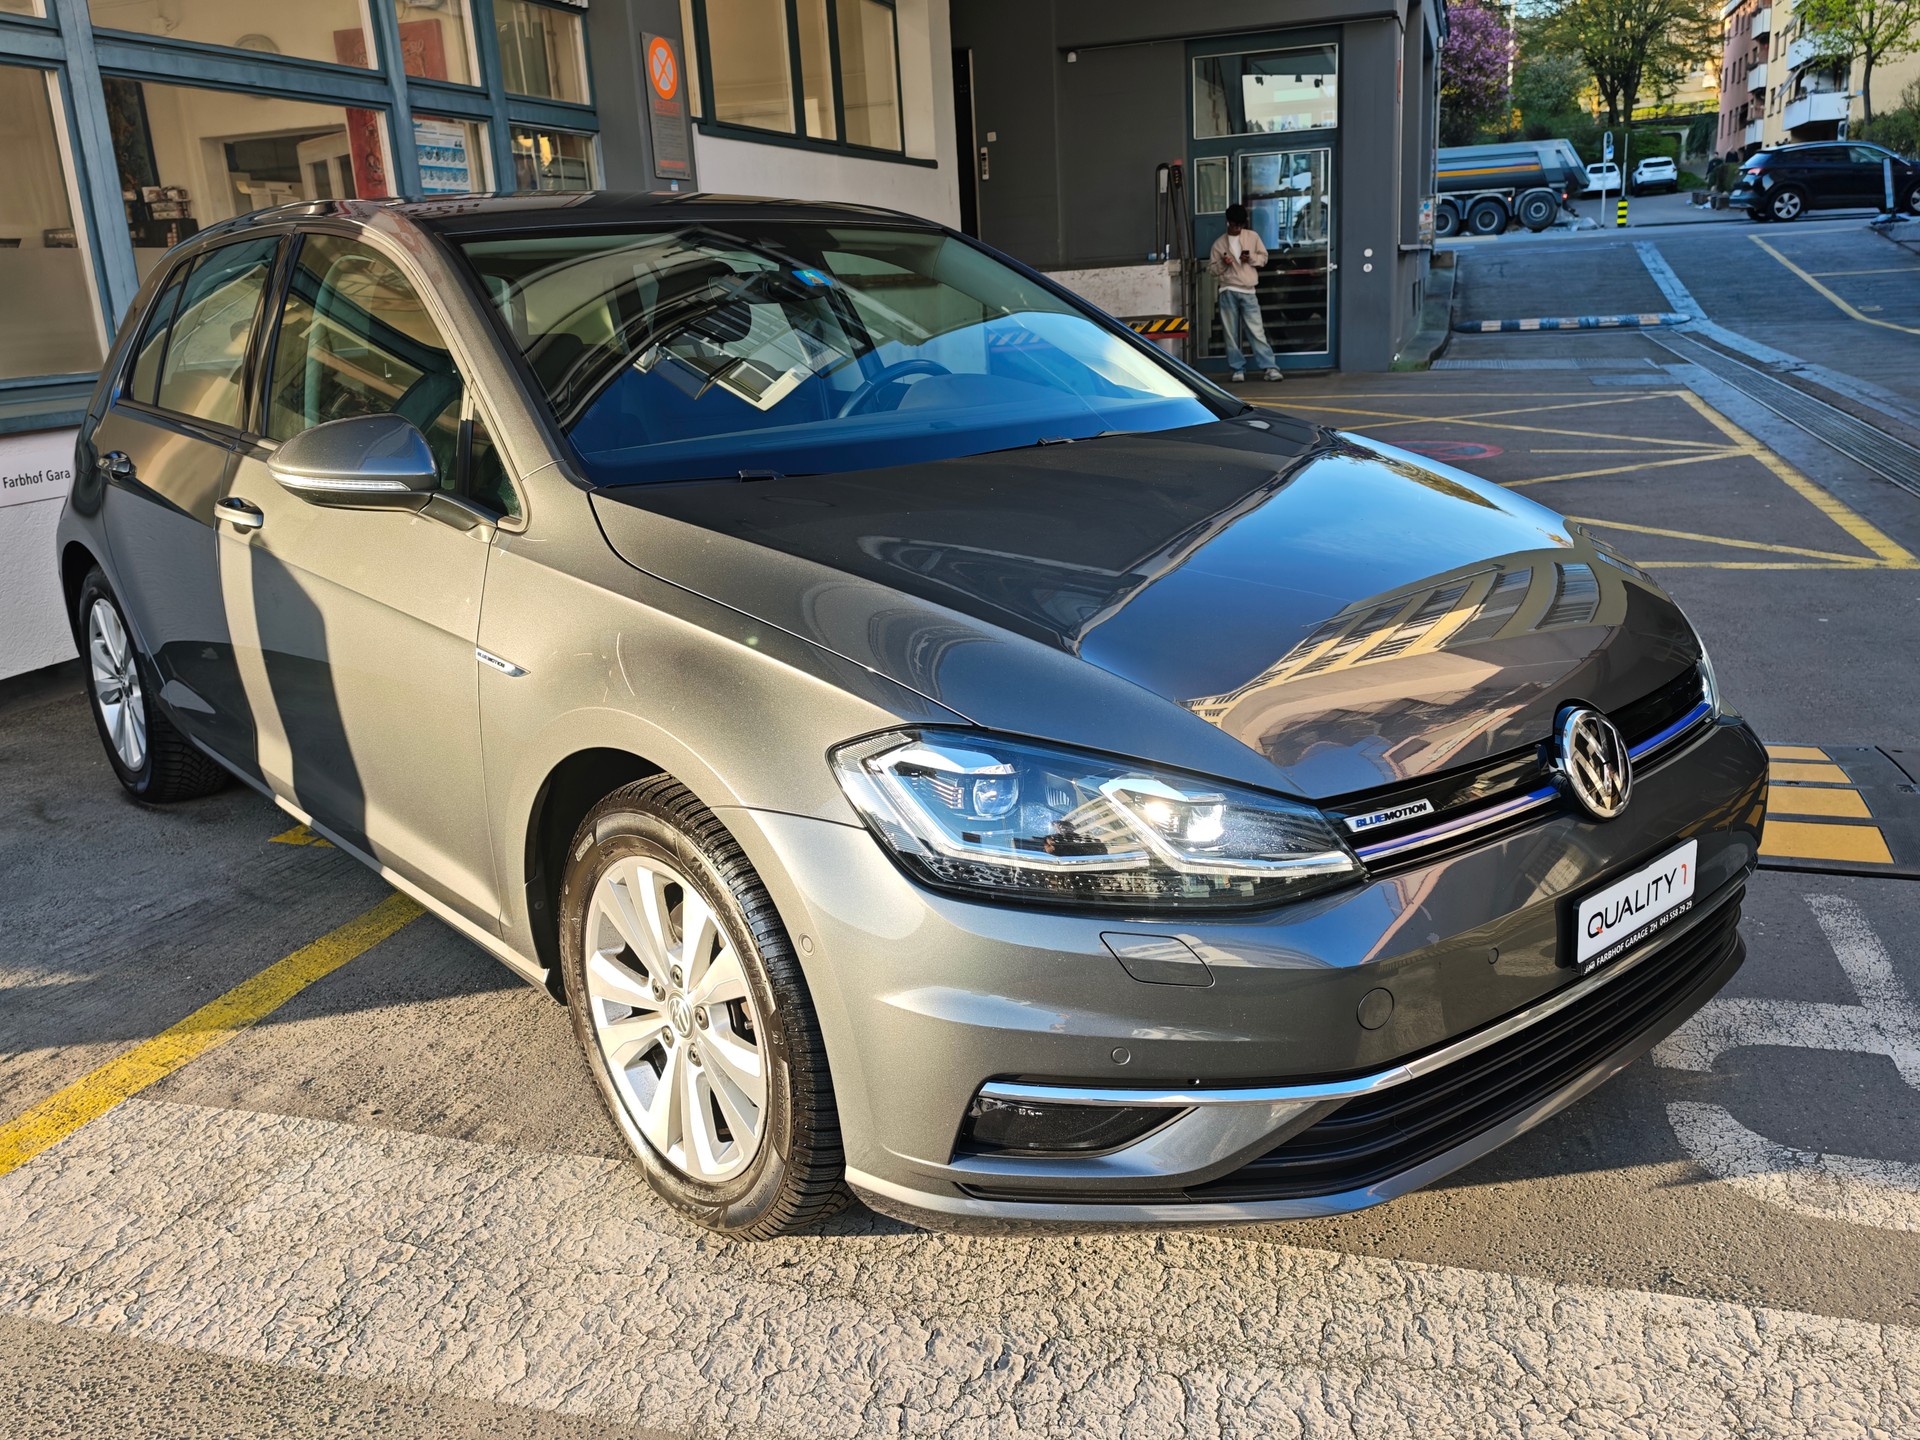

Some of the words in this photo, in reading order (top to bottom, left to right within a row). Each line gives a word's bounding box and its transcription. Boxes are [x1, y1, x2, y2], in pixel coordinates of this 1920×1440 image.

[2, 470, 43, 489] Farbhof
[46, 469, 71, 481] Gara
[1354, 802, 1427, 828] BLUEMOTION
[1596, 942, 1624, 967] FARBHOF
[1624, 927, 1649, 948] GARAGE
[1650, 921, 1658, 933] ZH
[1659, 914, 1669, 926] 043
[1669, 908, 1679, 920] 558
[1679, 904, 1685, 914] 29
[1685, 900, 1693, 910] 29
